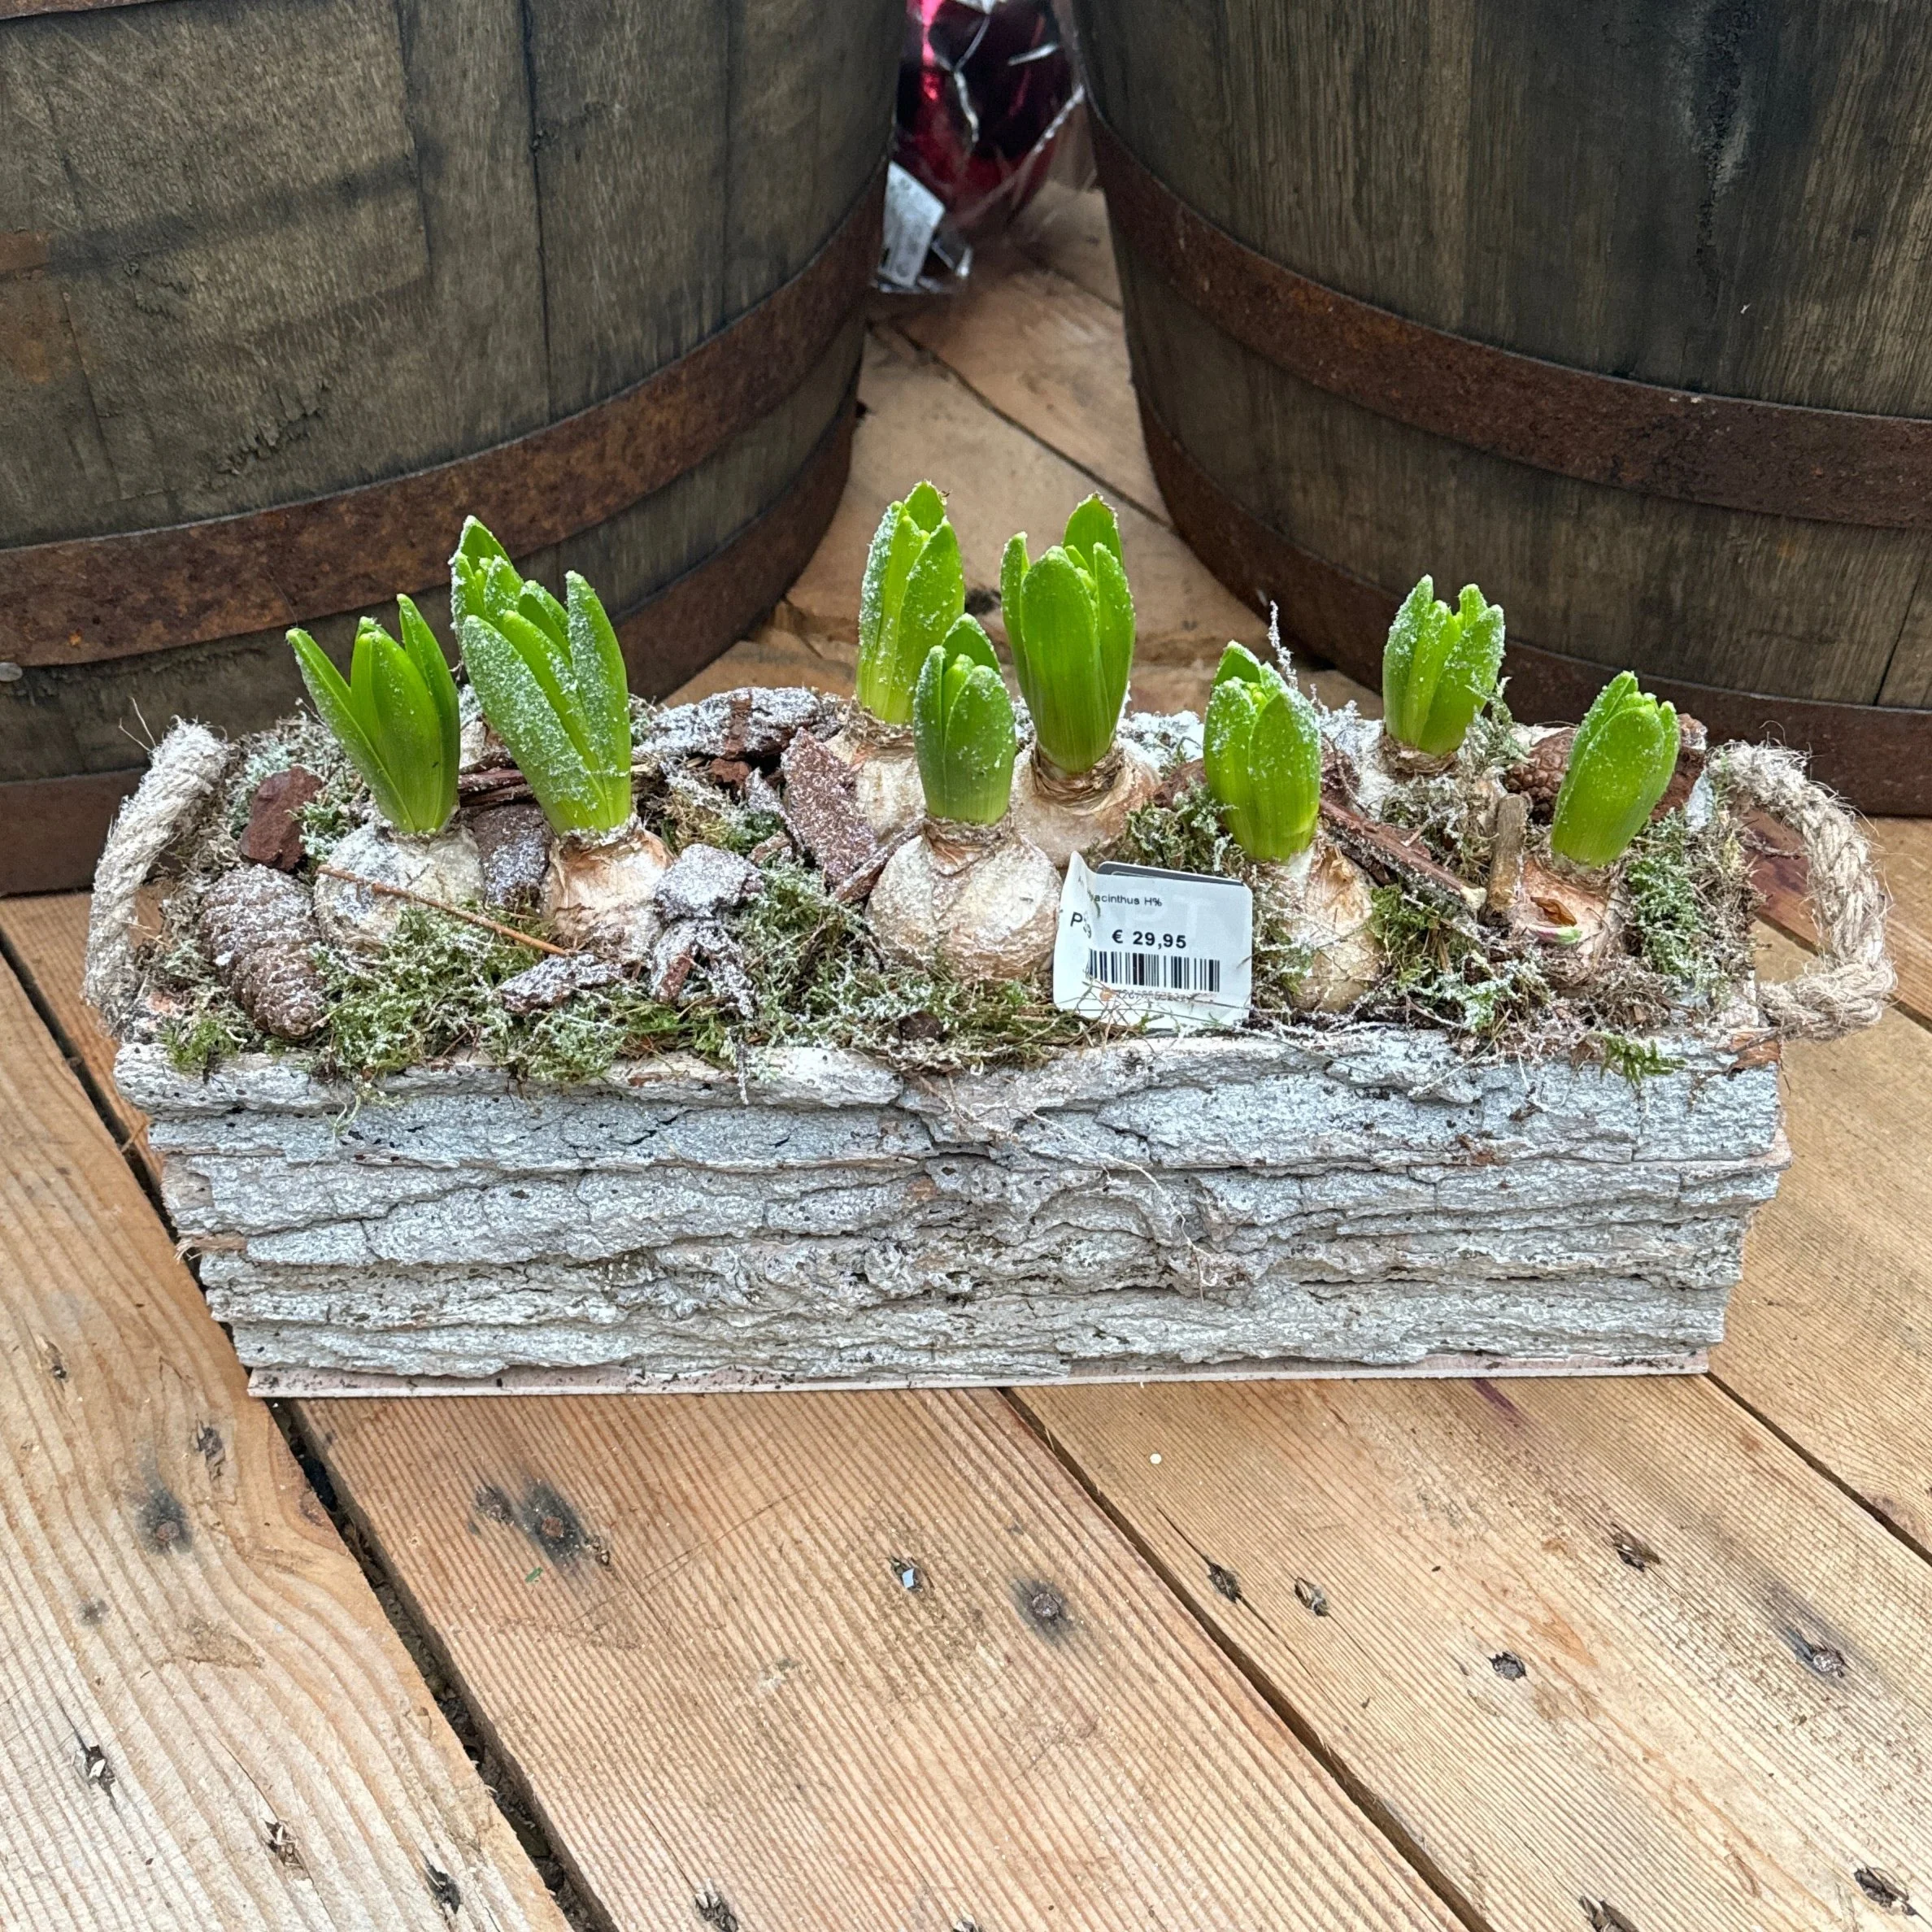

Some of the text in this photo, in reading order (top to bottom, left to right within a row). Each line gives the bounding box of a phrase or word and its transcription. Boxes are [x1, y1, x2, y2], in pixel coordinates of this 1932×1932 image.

[1144, 897, 1163, 907] H%
[1112, 929, 1187, 950] € 29,95
